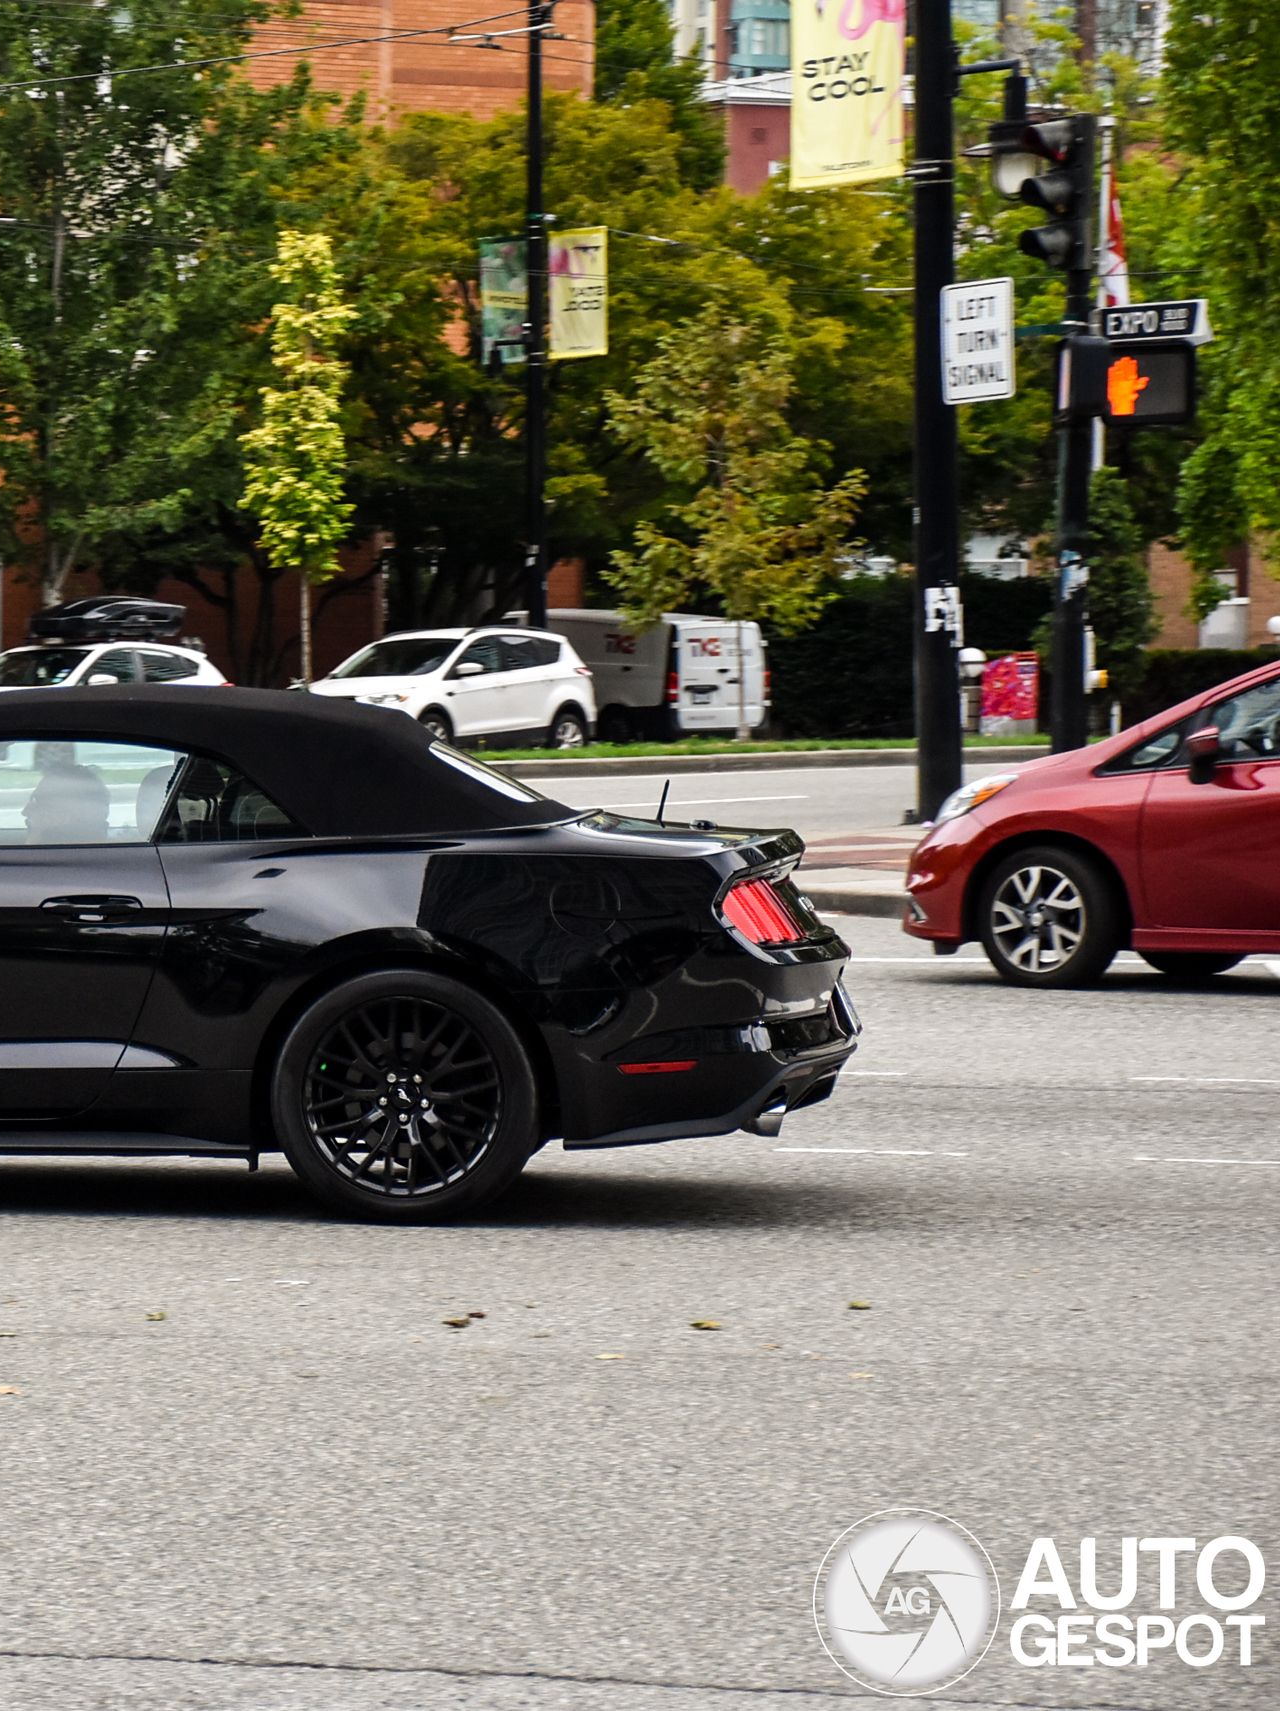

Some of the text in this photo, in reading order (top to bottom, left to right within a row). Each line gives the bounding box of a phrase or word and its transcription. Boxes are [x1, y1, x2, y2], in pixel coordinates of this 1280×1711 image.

[802, 51, 870, 78] STAY
[808, 75, 885, 102] COOL
[956, 296, 996, 321] LEFT
[1106, 310, 1159, 335] EXPO
[956, 329, 1000, 354] TURN
[948, 361, 1008, 387] SIGNAL
